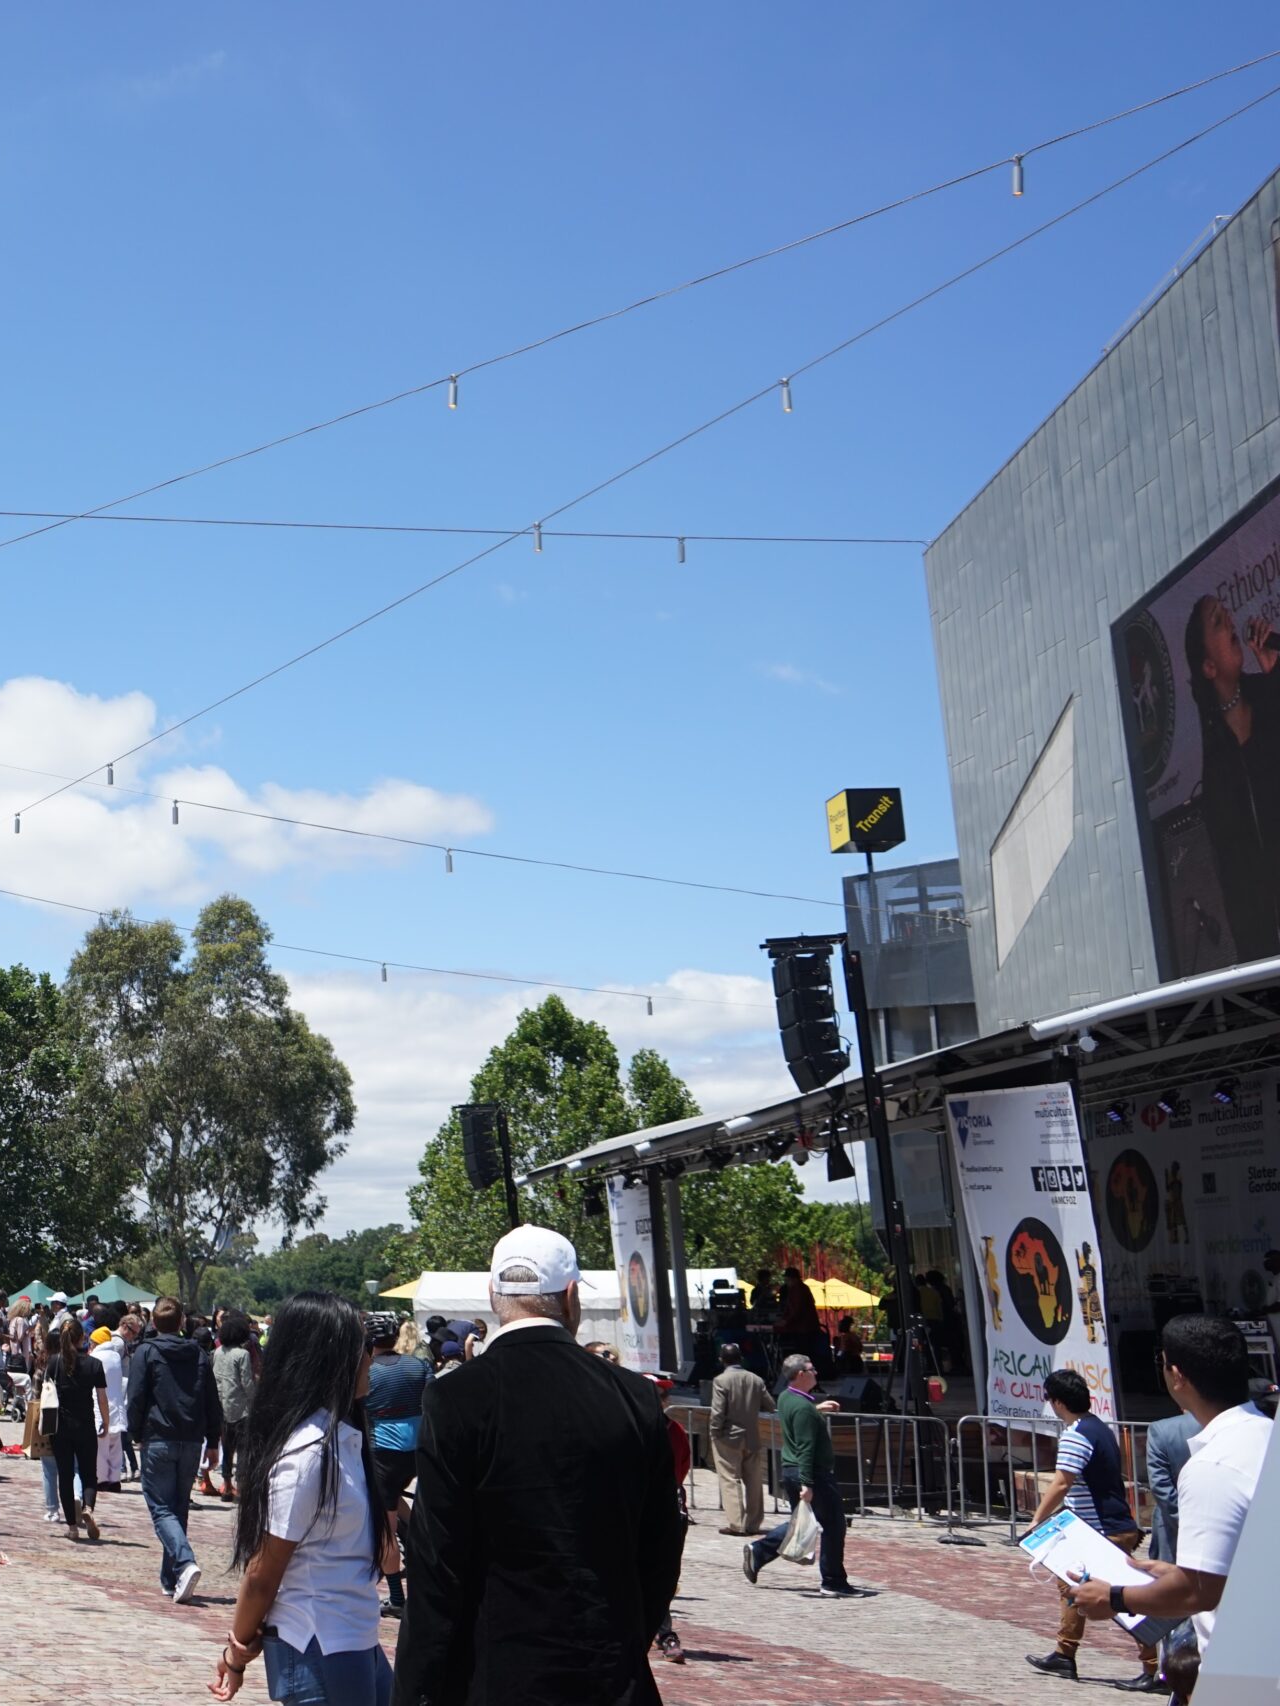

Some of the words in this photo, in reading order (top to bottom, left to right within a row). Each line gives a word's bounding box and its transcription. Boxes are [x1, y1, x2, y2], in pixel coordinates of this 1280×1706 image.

[856, 795, 894, 832] Transit
[1198, 1097, 1263, 1124] multicultural
[955, 1114, 993, 1129] VICTORIA
[1216, 1120, 1264, 1137] commission
[1247, 1166, 1278, 1180] Slater
[1205, 1231, 1273, 1255] worldremit
